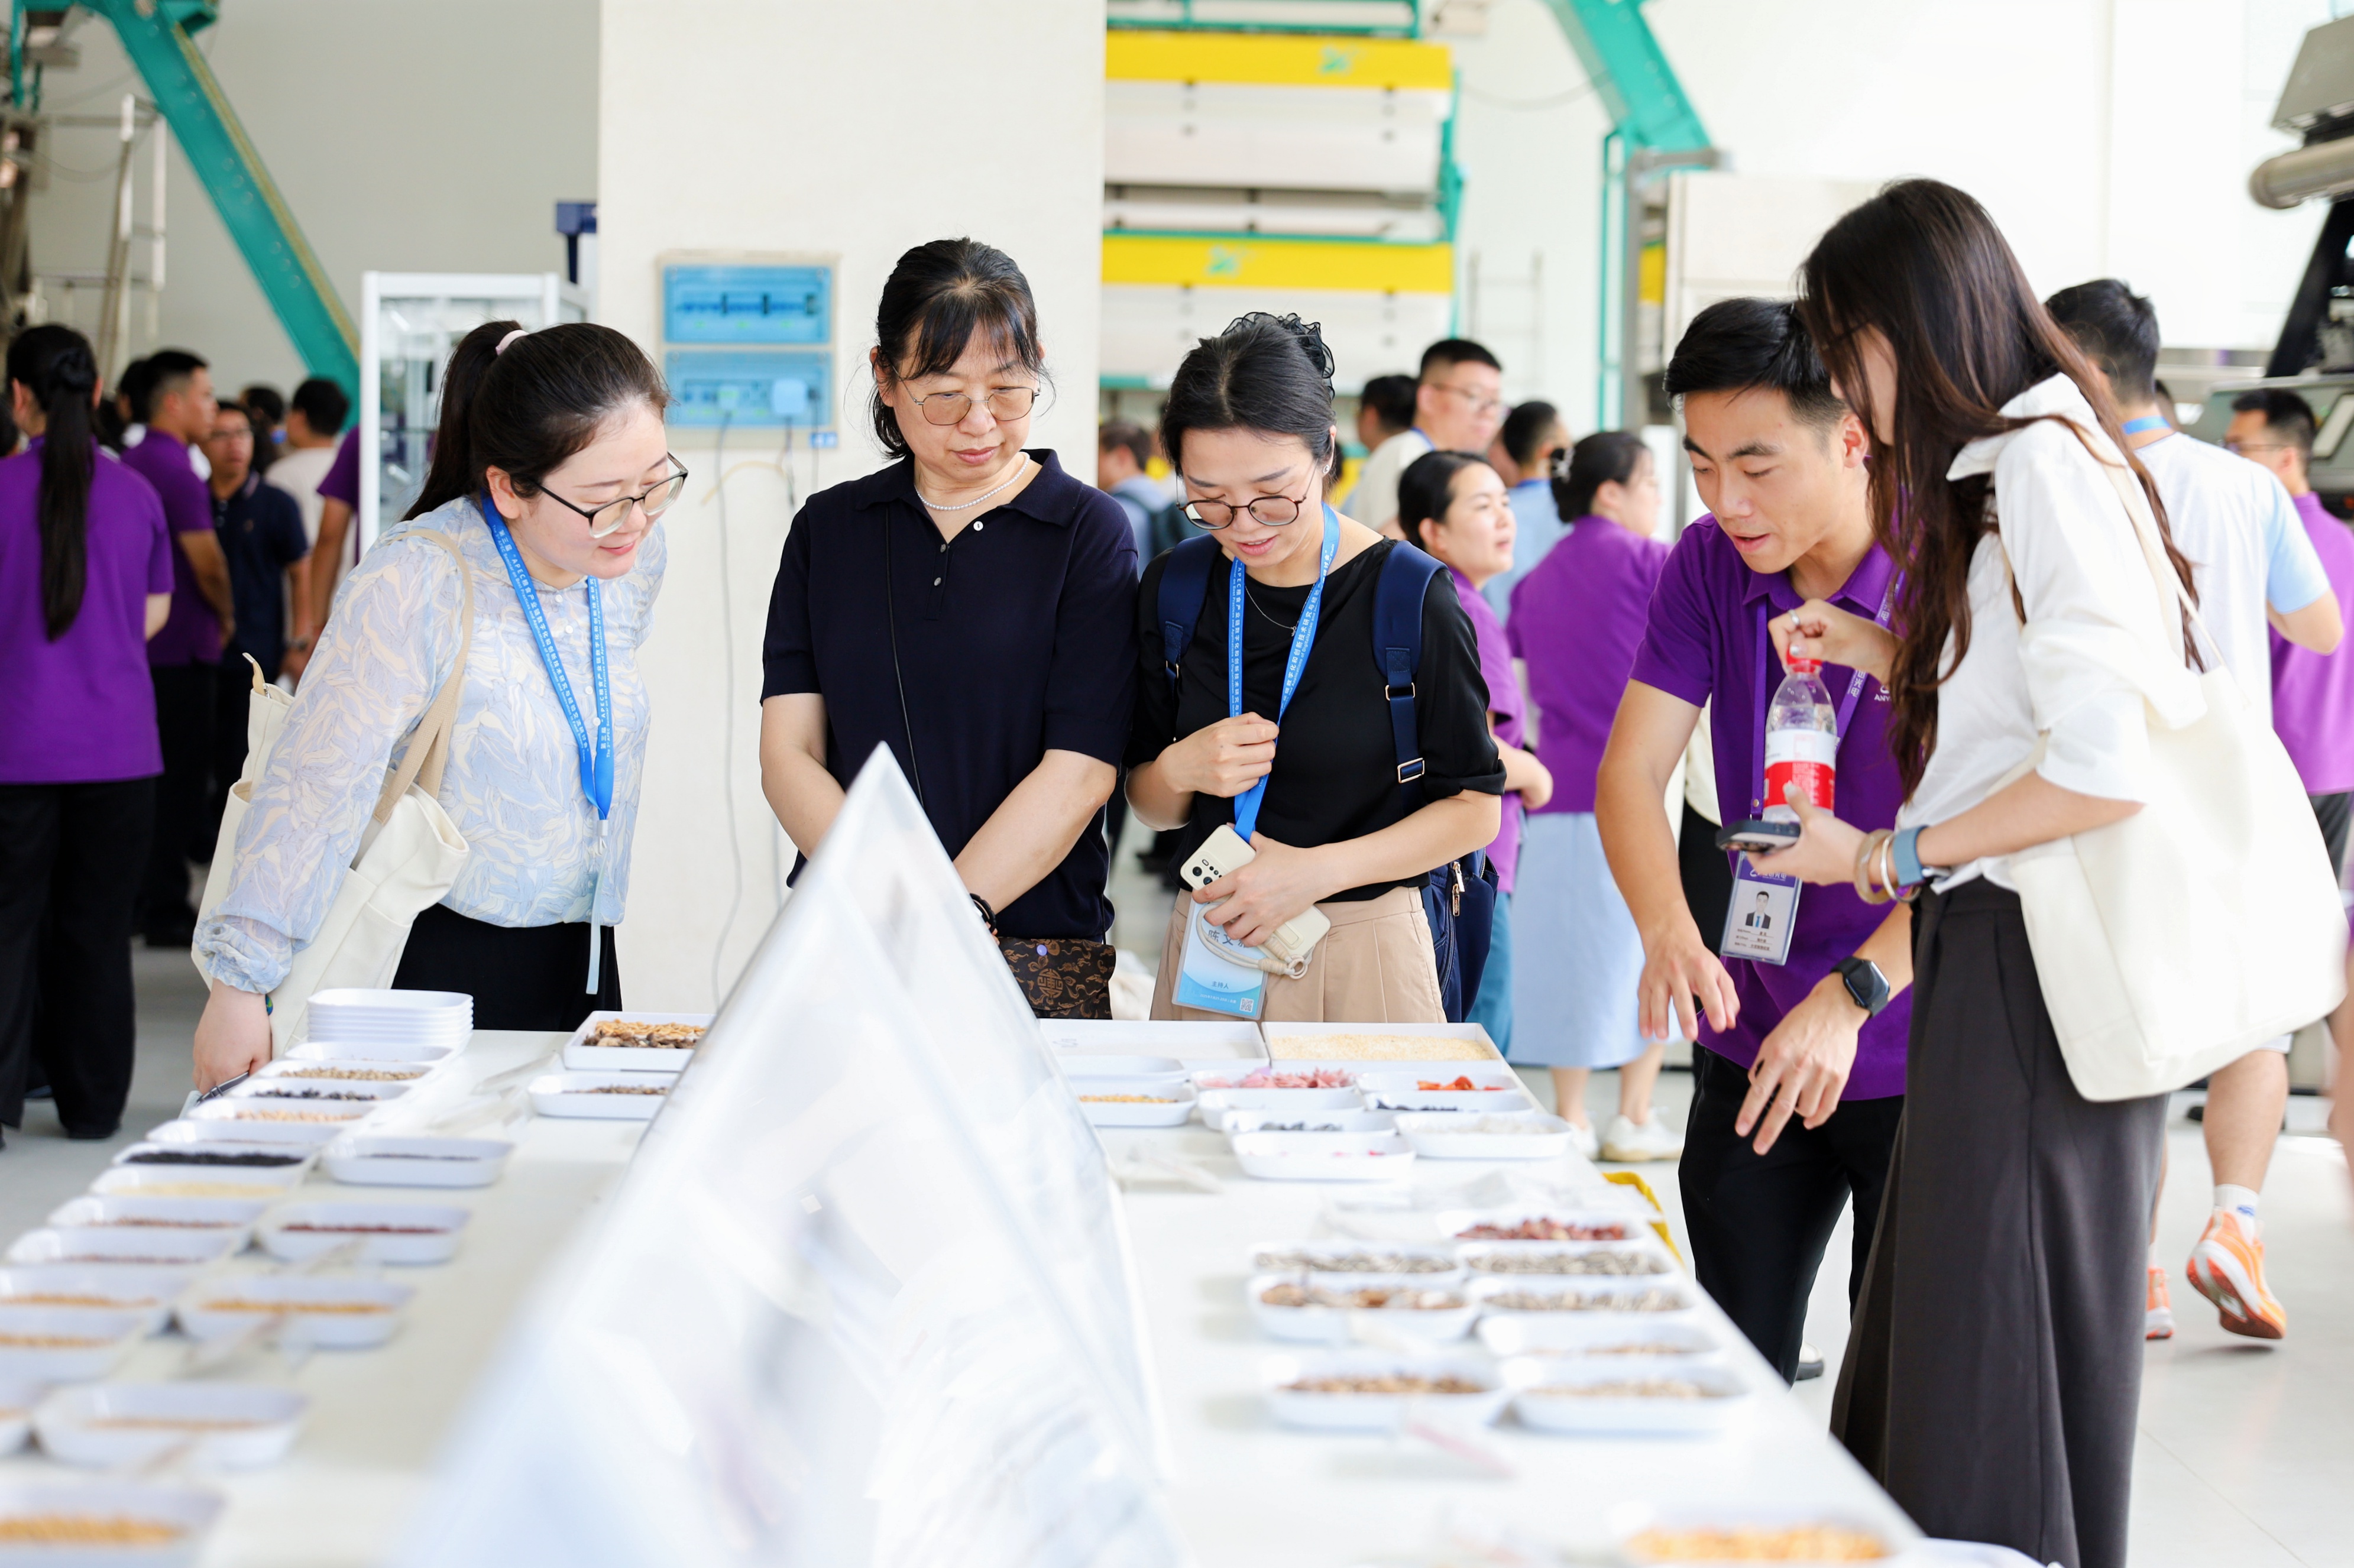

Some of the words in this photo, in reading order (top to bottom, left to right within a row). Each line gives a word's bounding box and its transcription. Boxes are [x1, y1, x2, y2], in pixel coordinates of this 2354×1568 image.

[497, 539, 506, 552] APEC
[503, 552, 514, 571] Seminar
[520, 588, 531, 610] Practices
[532, 618, 546, 647] Applications
[545, 653, 559, 682] Digitalization
[561, 691, 572, 715] Innovation
[1291, 659, 1303, 686] Applications
[1301, 622, 1313, 652] Digitalization
[1874, 694, 1892, 702] ANY
[1208, 929, 1246, 948] 陈文
[1212, 981, 1229, 989] 主持人
